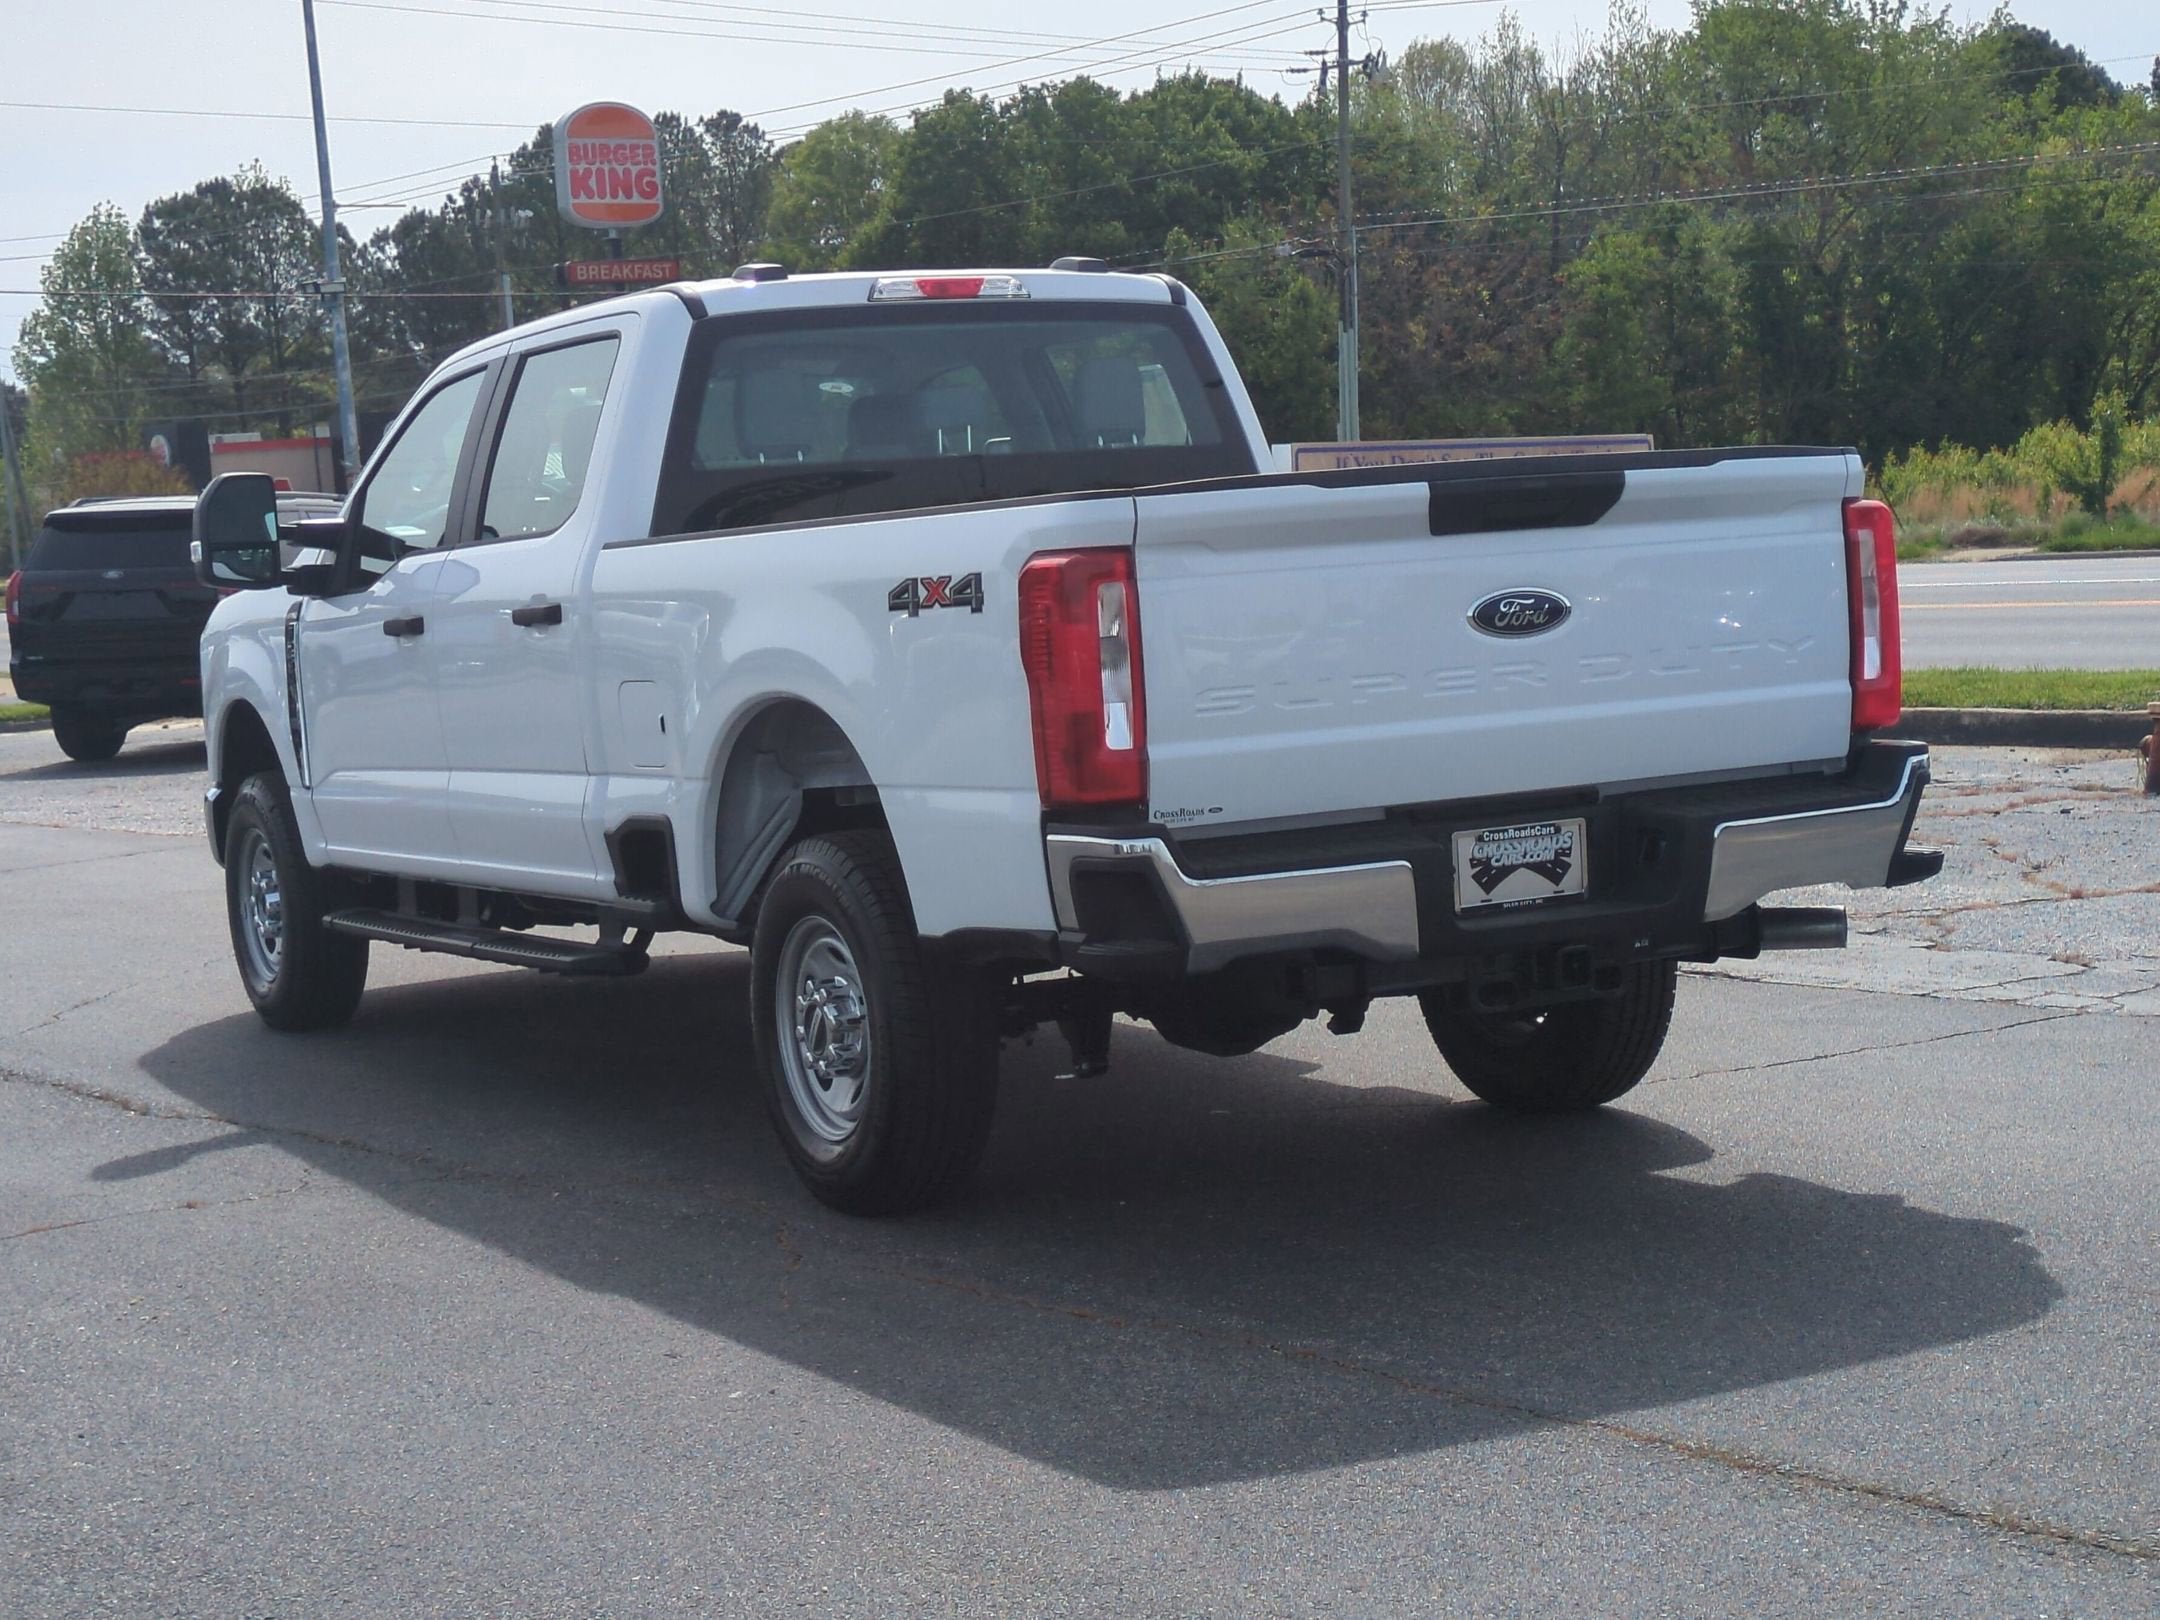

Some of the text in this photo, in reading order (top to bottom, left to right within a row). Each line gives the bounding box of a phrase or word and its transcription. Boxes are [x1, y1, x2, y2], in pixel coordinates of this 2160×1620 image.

[567, 142, 657, 166] BURGER
[569, 167, 659, 200] KING
[576, 263, 672, 280] BREAKFAST
[1495, 598, 1549, 627] Ford
[1195, 634, 1815, 717] SUPER DUTY
